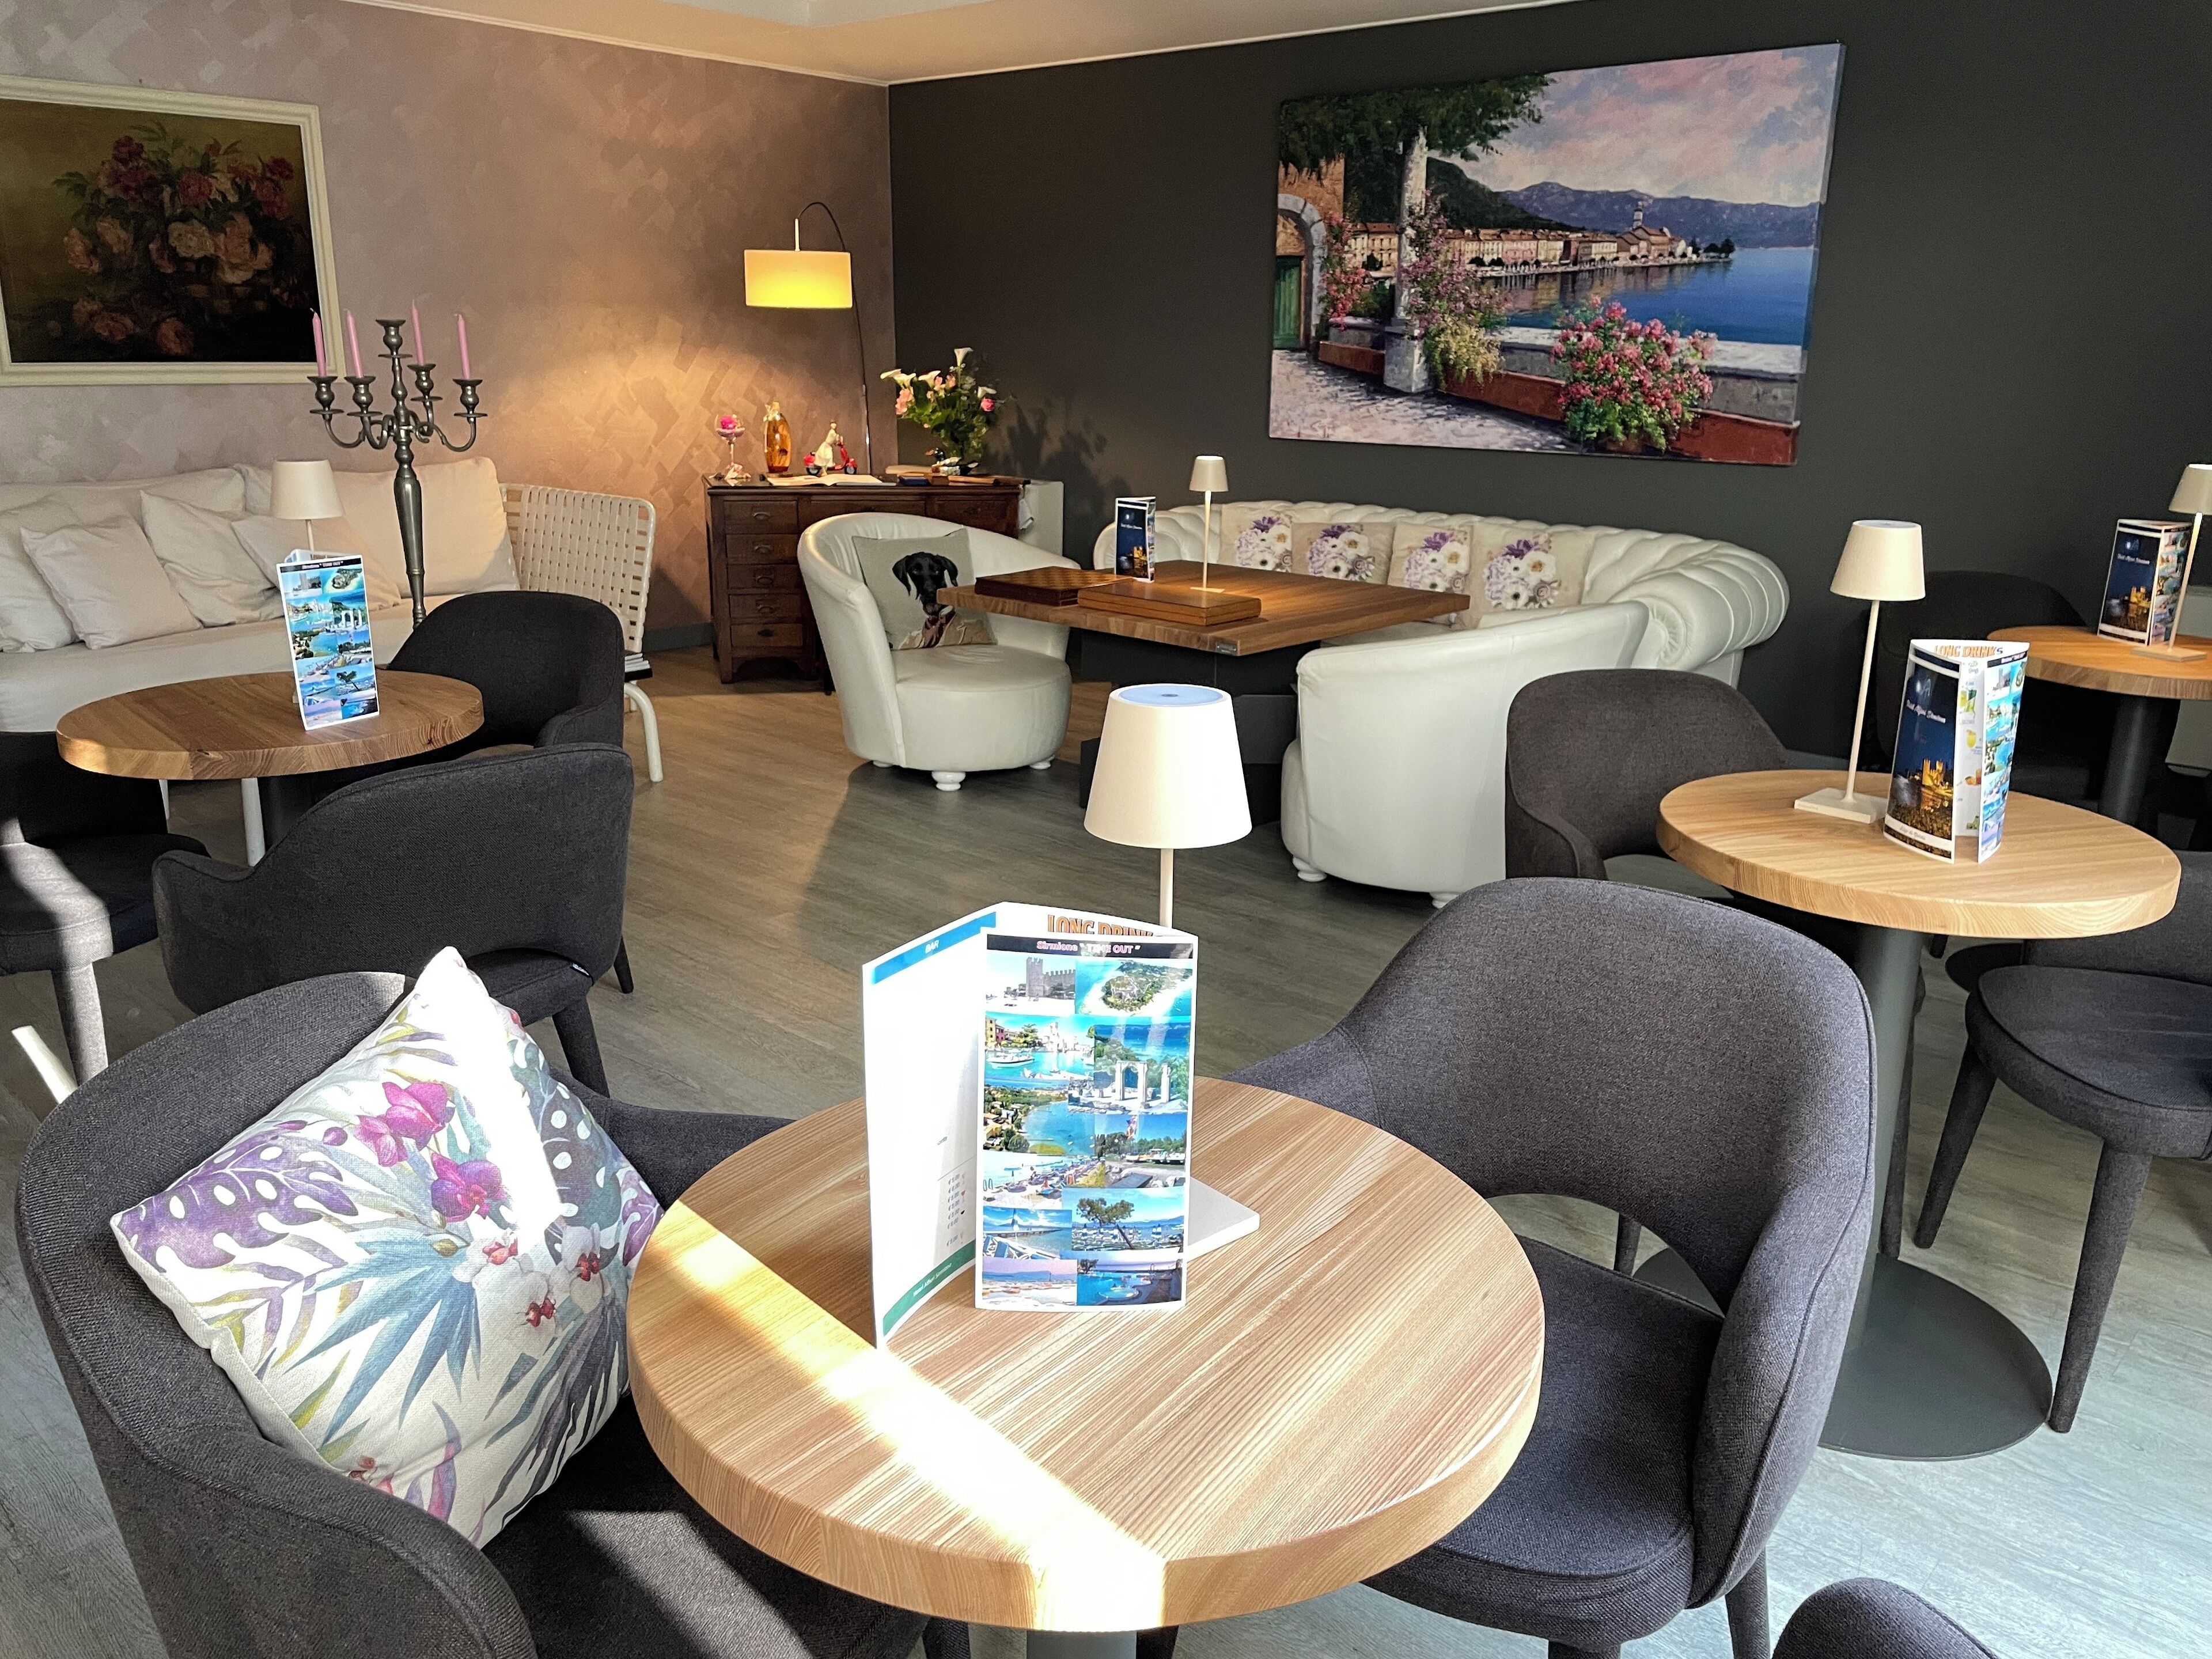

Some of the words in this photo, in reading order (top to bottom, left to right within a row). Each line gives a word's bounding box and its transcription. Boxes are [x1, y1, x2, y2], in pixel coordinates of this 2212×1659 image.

[1934, 645, 1961, 657] LONG
[1047, 914, 1095, 935] LONG
[1097, 922, 1154, 937] DRI
[925, 940, 940, 954] BAR
[1036, 940, 1078, 952] Sirmione
